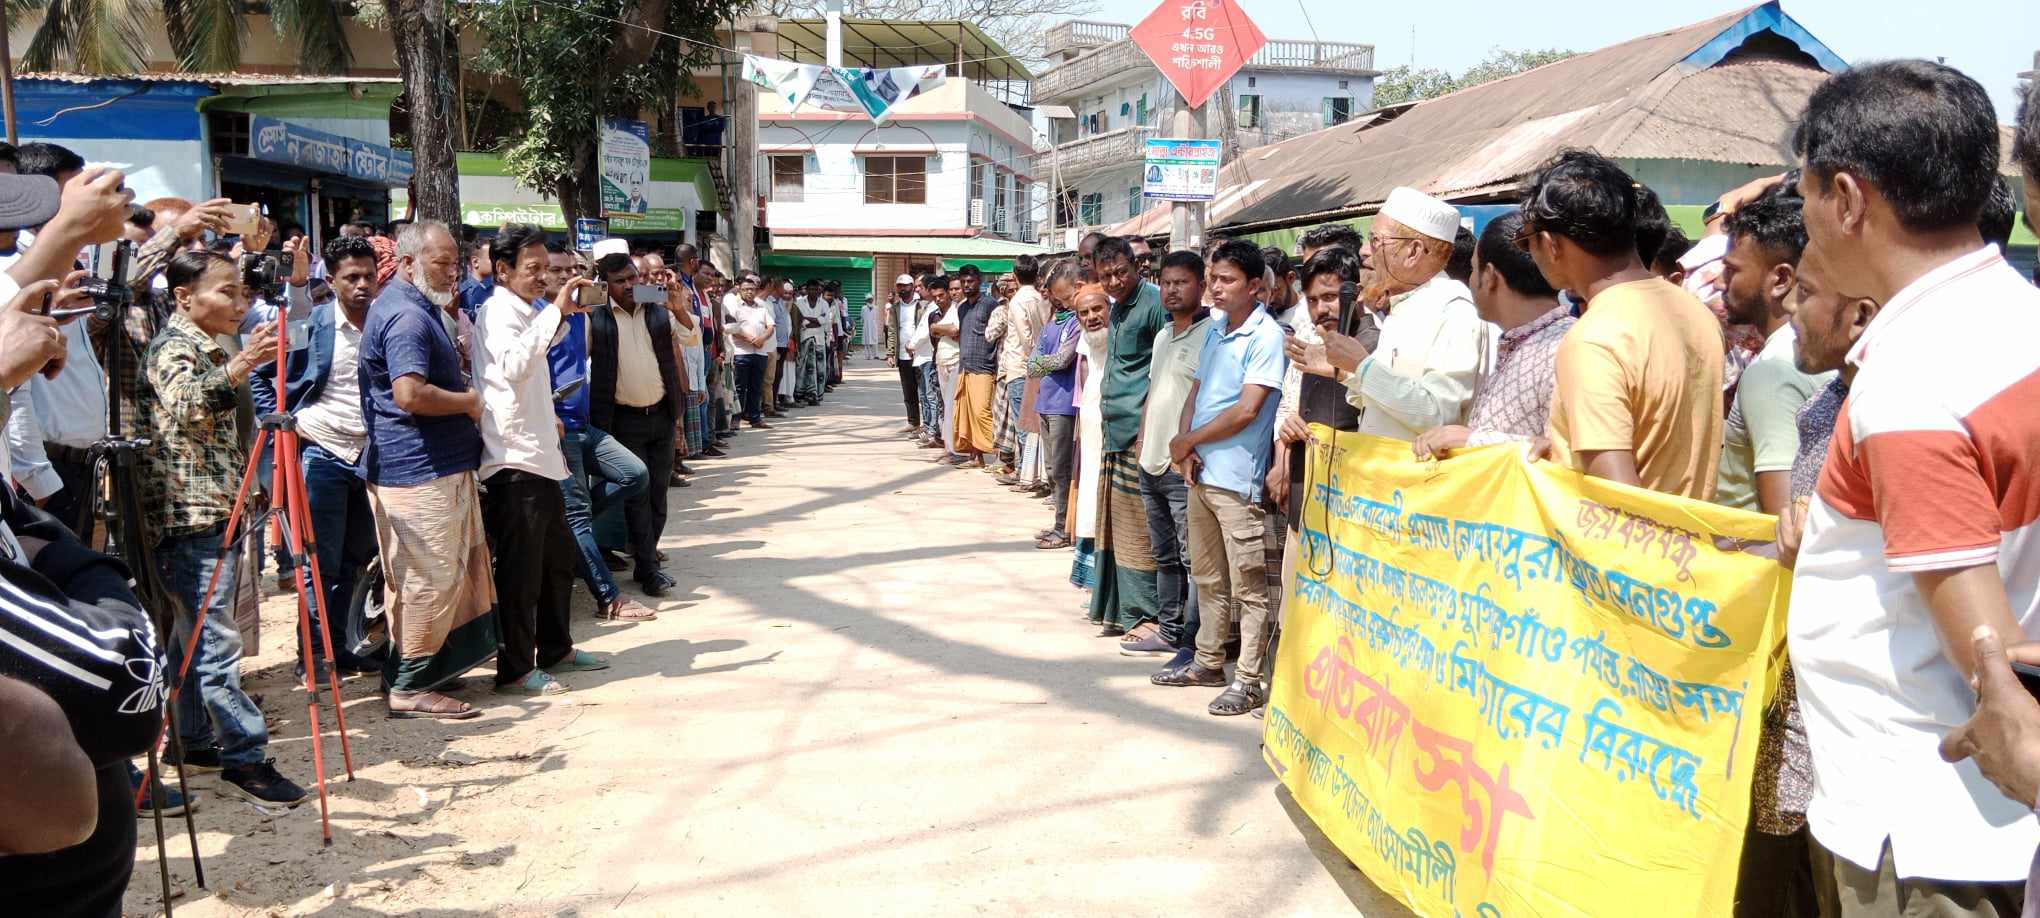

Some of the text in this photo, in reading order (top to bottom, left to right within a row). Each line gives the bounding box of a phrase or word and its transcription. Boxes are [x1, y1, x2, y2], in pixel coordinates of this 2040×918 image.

[1181, 1, 1207, 20] রবি
[1172, 43, 1194, 53] এখন
[1172, 55, 1222, 70] শক্তিশালী
[1577, 499, 1622, 540] জয়
[1303, 635, 1411, 786] প্রতিবাদ
